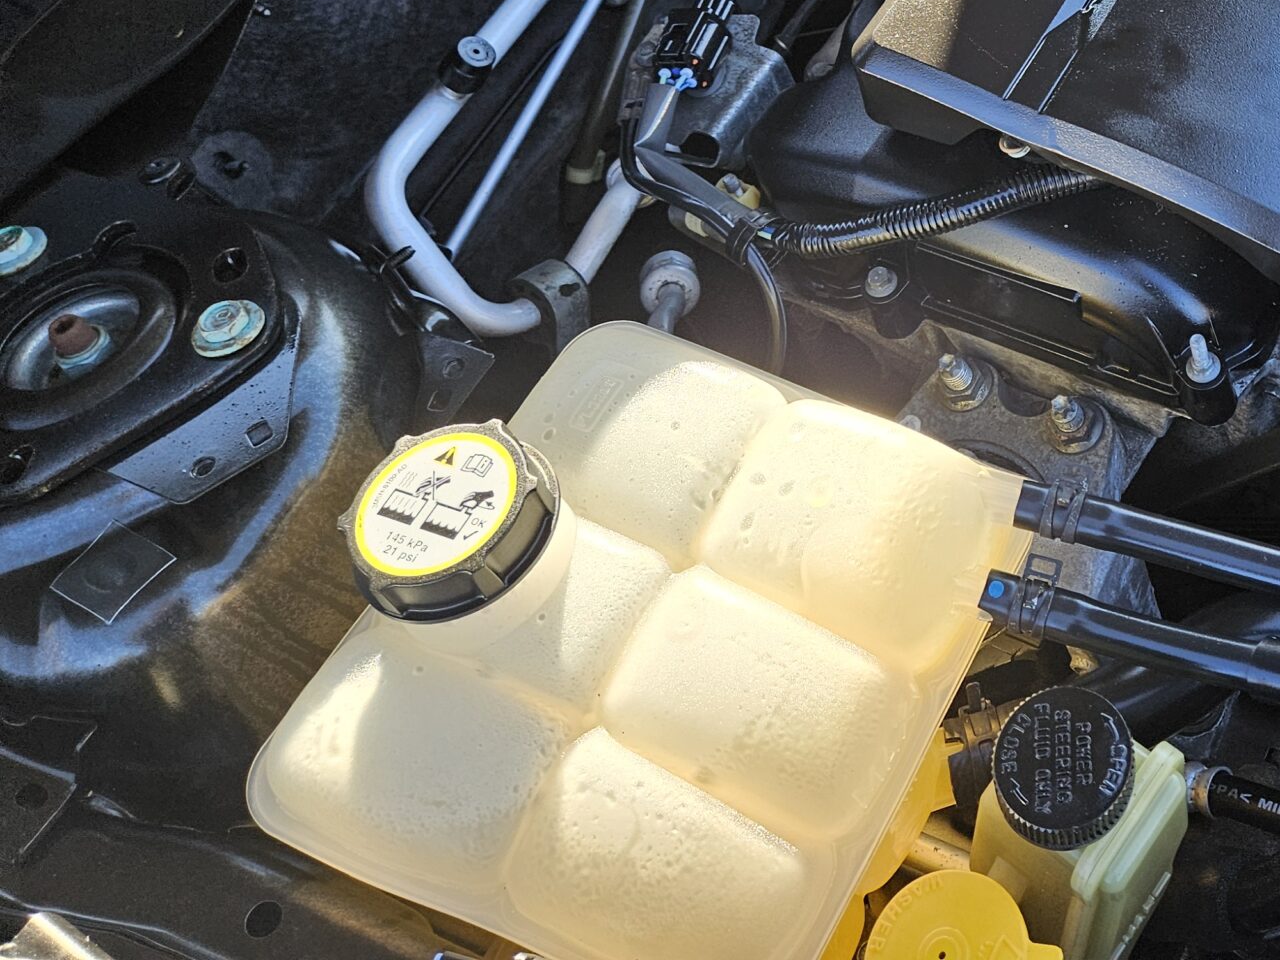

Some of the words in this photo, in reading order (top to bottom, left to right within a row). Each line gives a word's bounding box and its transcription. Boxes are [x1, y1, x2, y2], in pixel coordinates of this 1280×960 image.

[385, 530, 406, 546] 145
[407, 535, 429, 553] kPa
[470, 517, 487, 529] OK
[383, 544, 397, 557] 21
[397, 549, 418, 564] psi
[1000, 712, 1031, 774] CLOSE
[1033, 702, 1051, 759] FLUID
[1053, 709, 1073, 803] STEERING
[1075, 721, 1093, 785] POWER
[1034, 768, 1051, 814] ONLY
[1098, 743, 1127, 796] OPEN
[869, 872, 944, 950] WASHER
